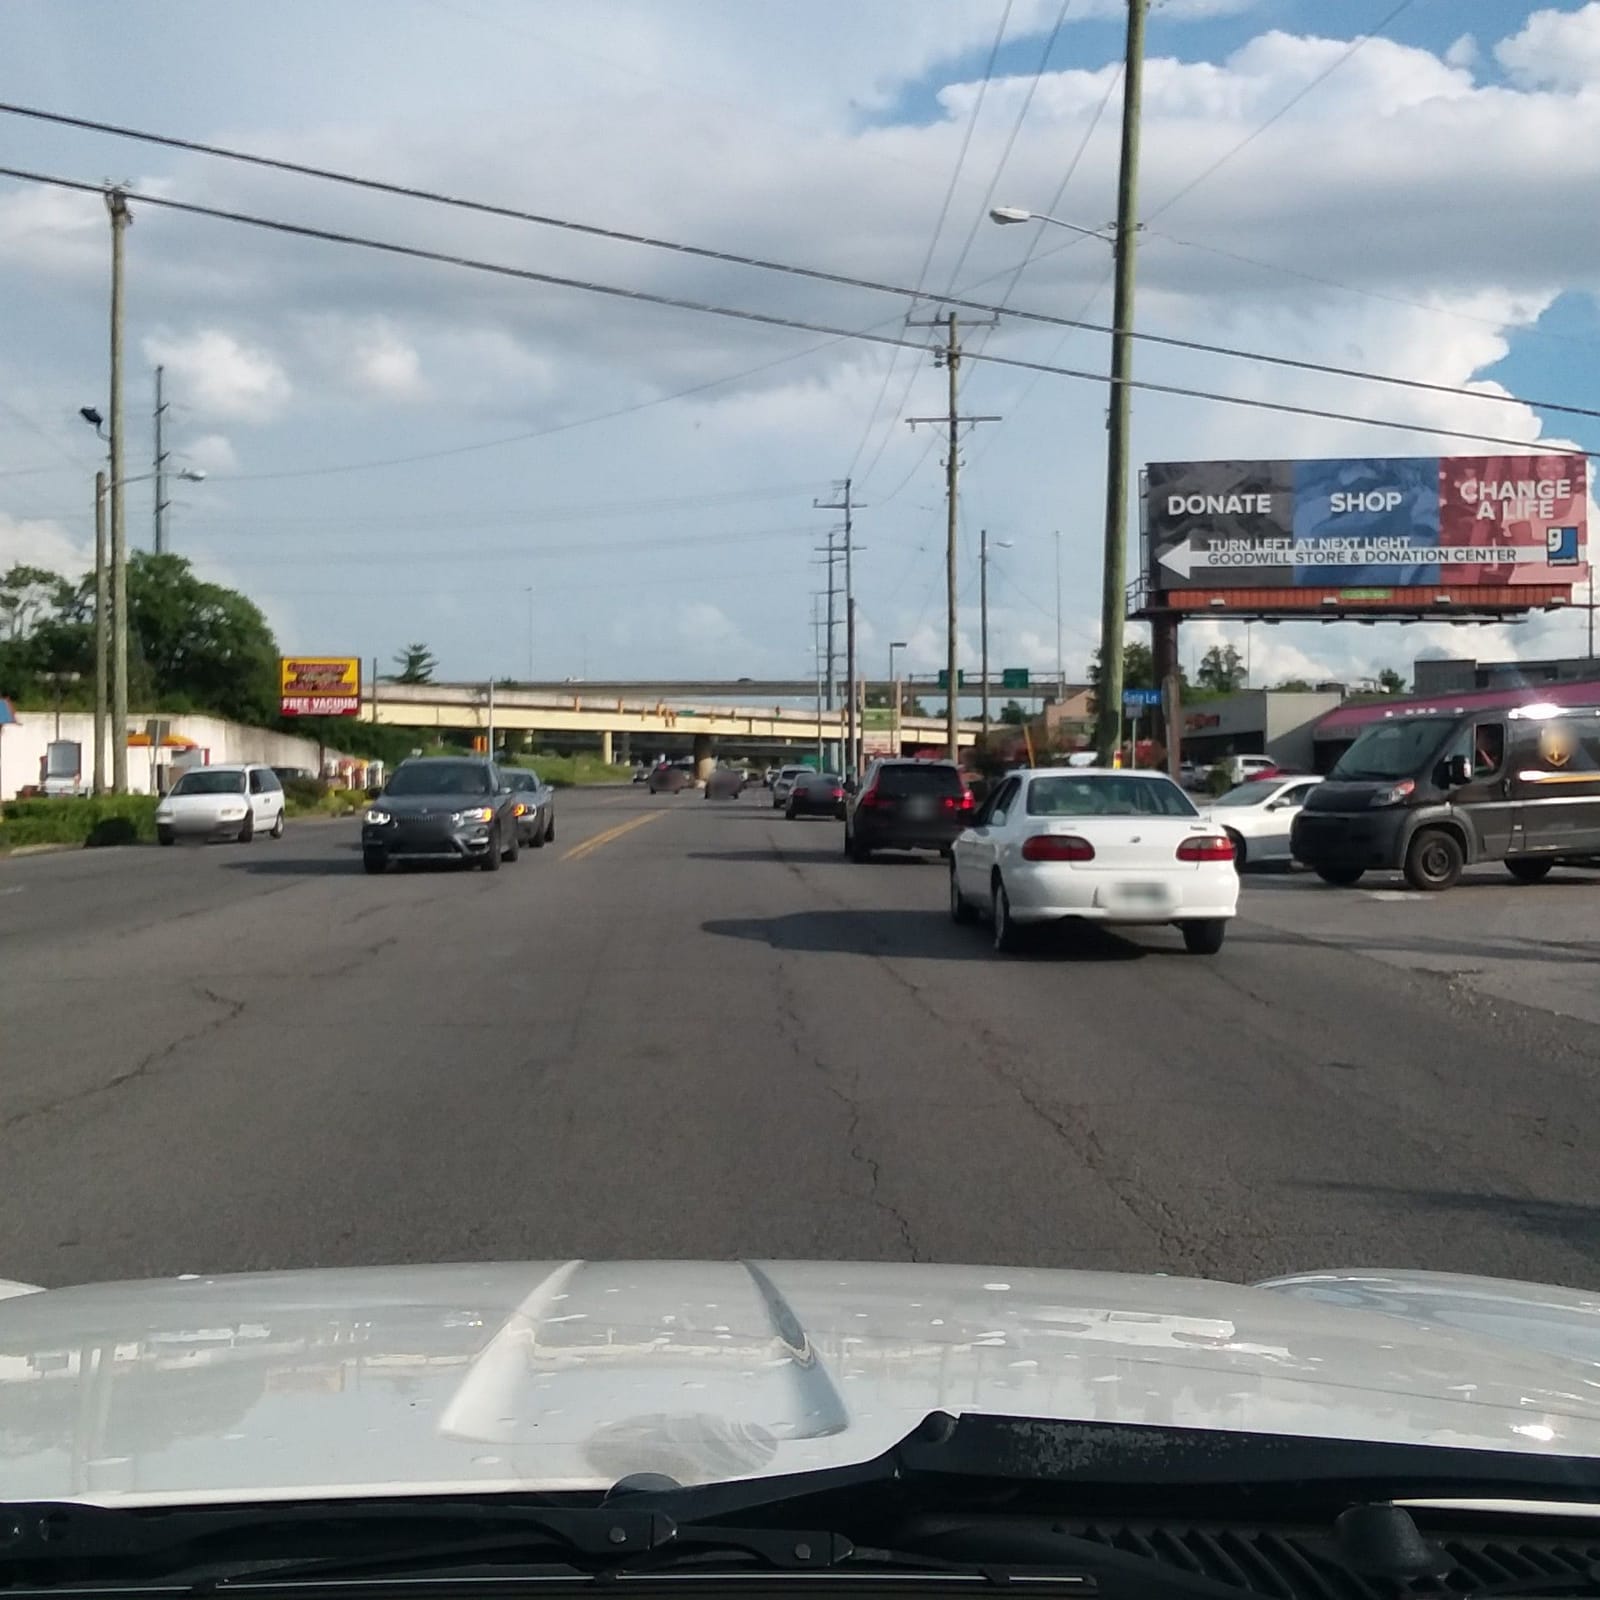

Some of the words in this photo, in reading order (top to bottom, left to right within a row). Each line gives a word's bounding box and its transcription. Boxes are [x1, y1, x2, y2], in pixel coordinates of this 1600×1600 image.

[1460, 479, 1571, 502] CHANGE
[1168, 494, 1271, 515] DONATE
[1330, 492, 1402, 512] SHOP
[1476, 501, 1496, 521] A
[1502, 499, 1555, 519] LIFE
[1207, 538, 1250, 552] TURN
[1255, 538, 1291, 551] LEFT
[1296, 538, 1322, 551] AT
[1323, 537, 1361, 551] NEXT
[1364, 536, 1411, 550] LIGHT
[1207, 551, 1290, 565] GOODWILL
[1295, 551, 1346, 564] STORE
[1350, 551, 1360, 563] &
[1365, 550, 1450, 563] DONATION
[1454, 549, 1517, 562] CENTER
[282, 697, 308, 710] FREE
[312, 697, 358, 710] VACUUM
